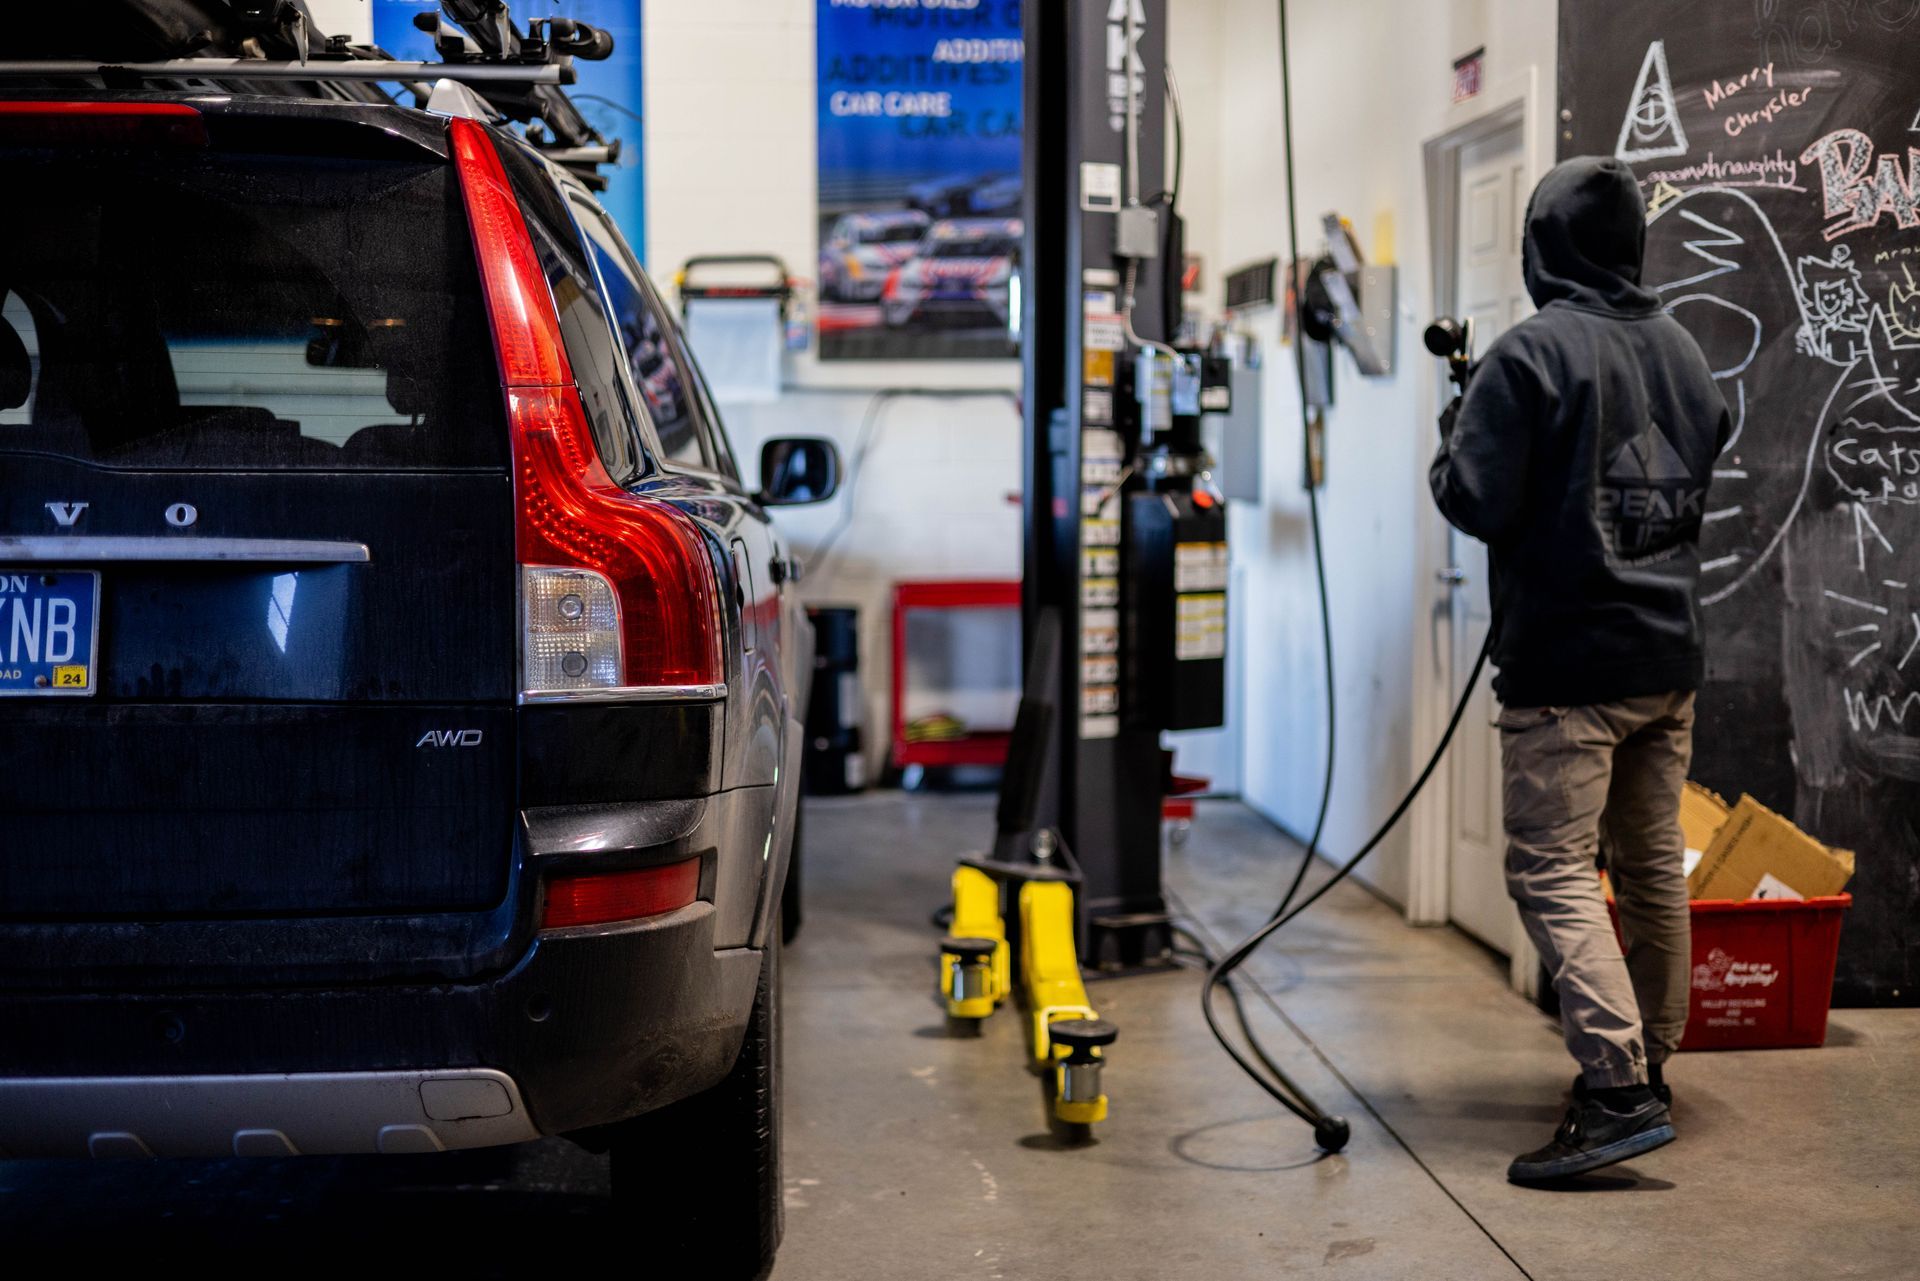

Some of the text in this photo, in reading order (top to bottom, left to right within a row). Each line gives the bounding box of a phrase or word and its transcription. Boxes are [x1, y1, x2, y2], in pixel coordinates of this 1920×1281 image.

[932, 38, 1025, 63] ADDITI
[1702, 62, 1774, 110] Marry
[830, 91, 952, 117] CAR CARE
[1724, 86, 1812, 137] Chrysler
[1594, 487, 1704, 519] PEAK
[0, 597, 77, 663] NB
[63, 674, 81, 684] 24
[415, 729, 483, 747] AWD
